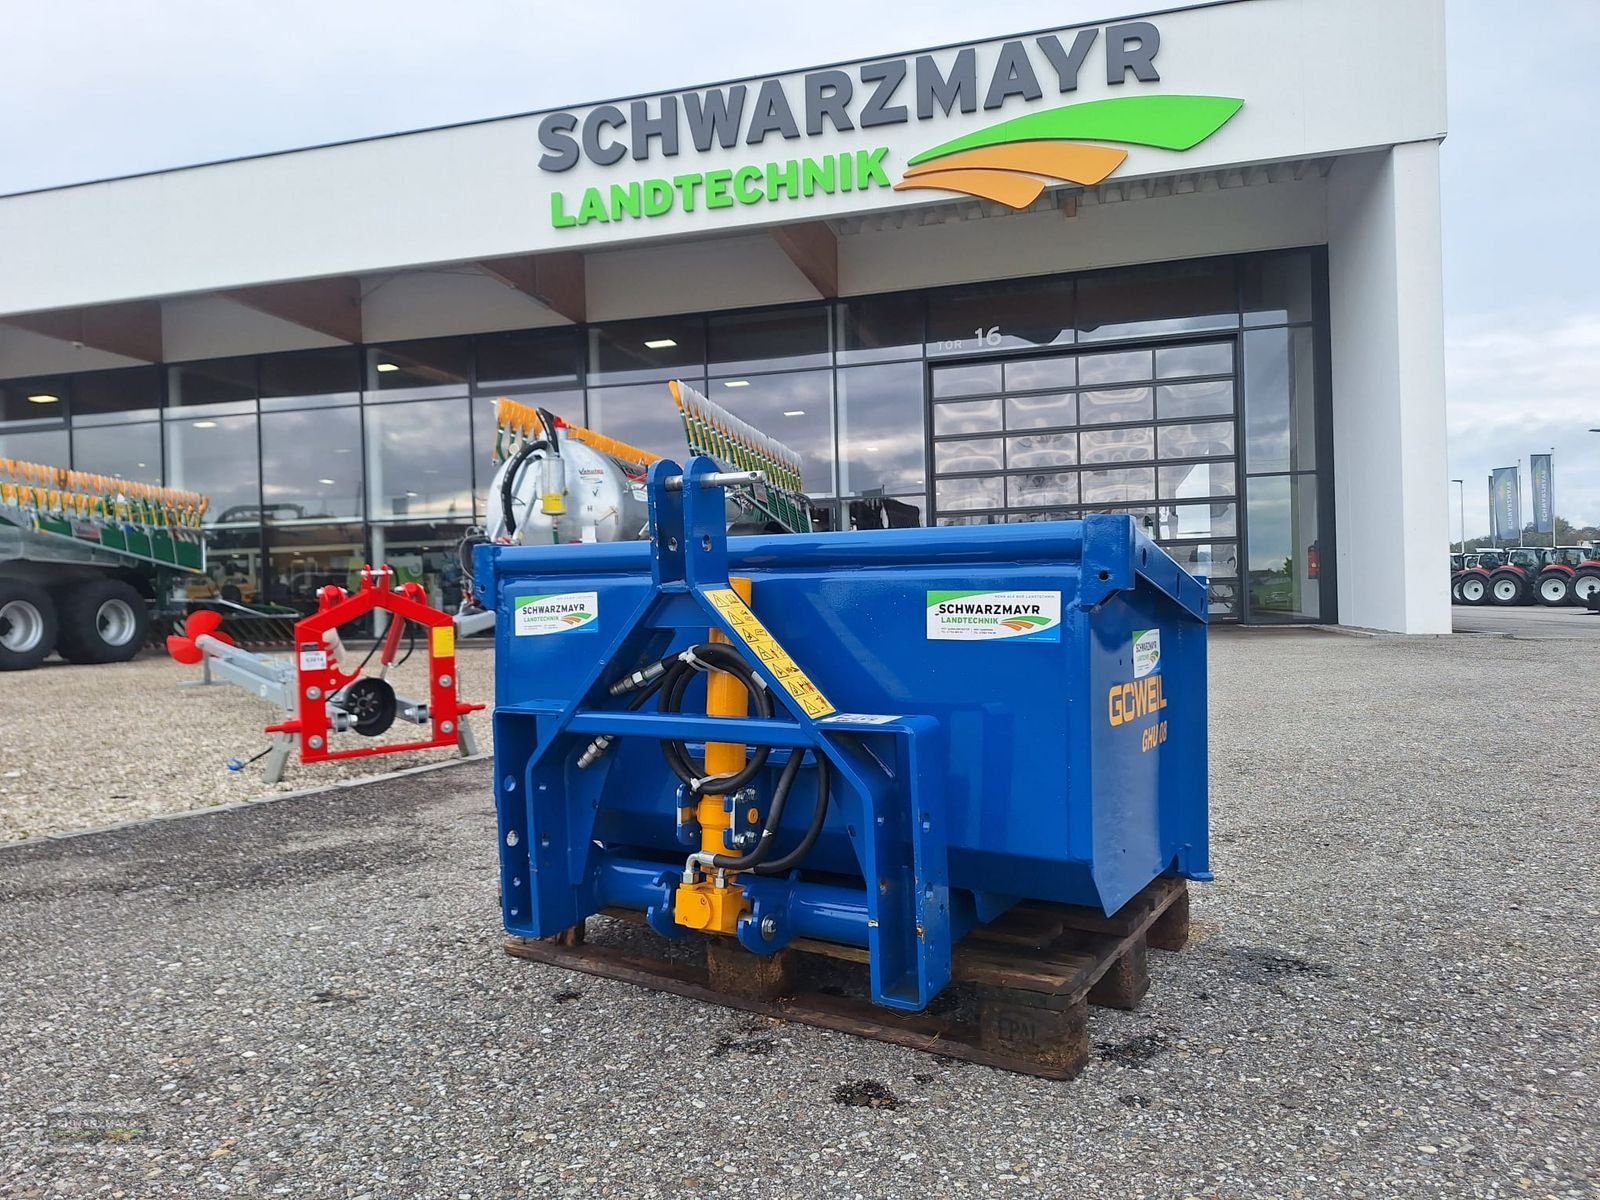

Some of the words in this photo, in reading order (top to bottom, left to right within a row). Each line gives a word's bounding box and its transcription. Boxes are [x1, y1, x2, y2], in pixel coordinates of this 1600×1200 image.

[537, 21, 1161, 172] SCHWARZMAYR
[550, 147, 892, 229] LANDTECHNIK
[937, 340, 962, 350] TOR
[975, 326, 1002, 347] 16
[522, 603, 585, 615] SCHWARZMAYR
[939, 604, 1040, 615] SCHWARZMAYR
[941, 617, 998, 625] LANDTECHNIK
